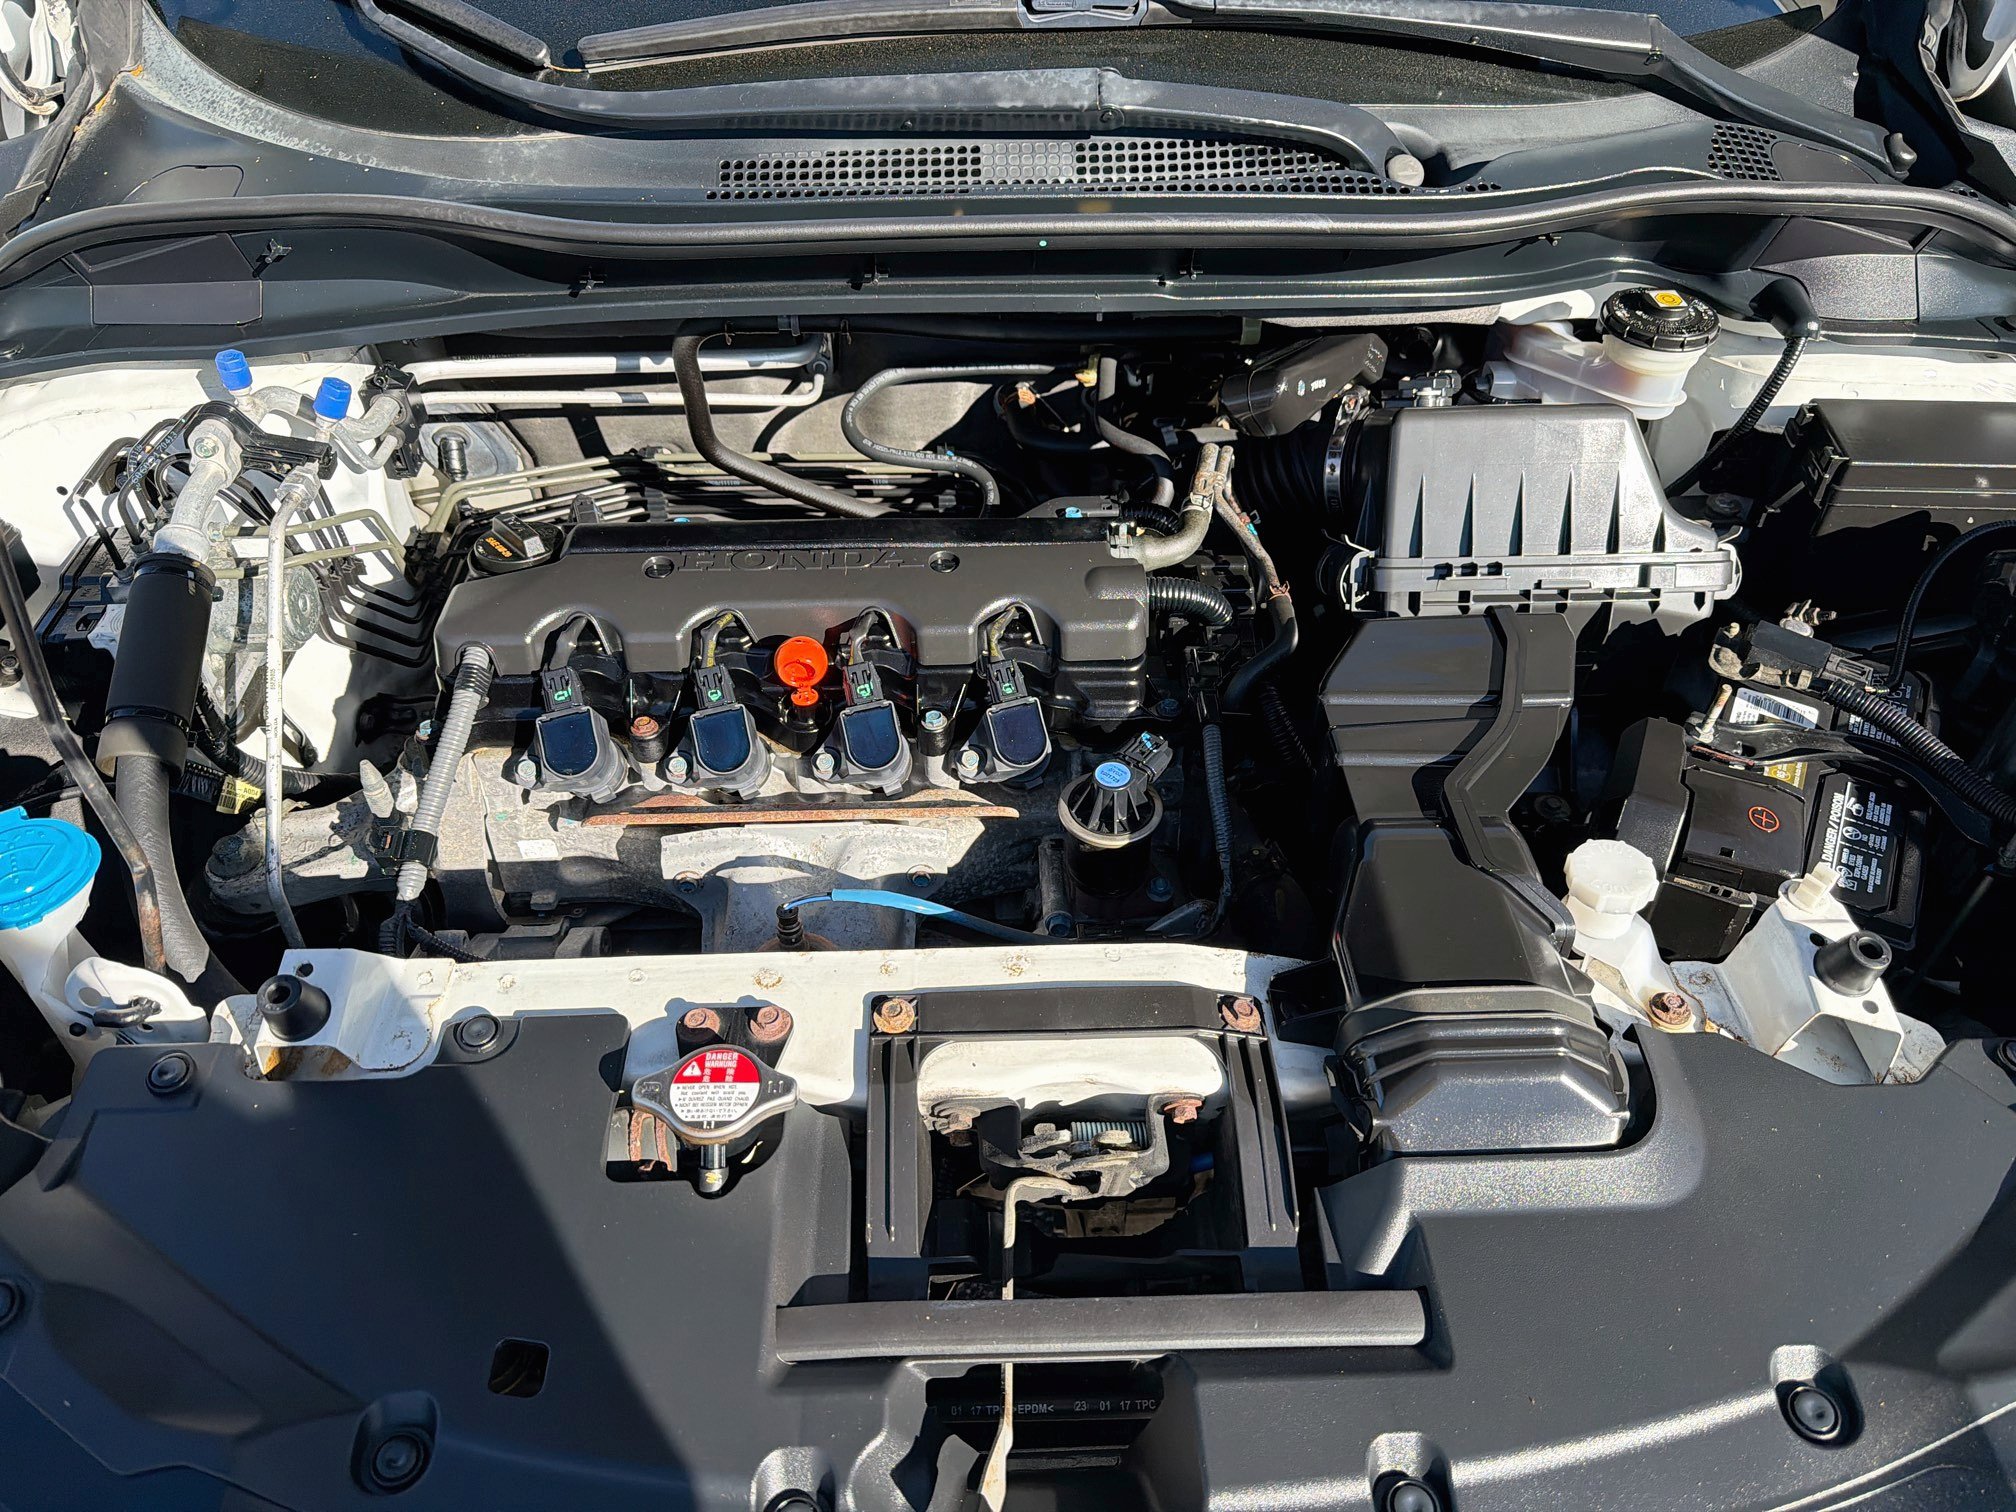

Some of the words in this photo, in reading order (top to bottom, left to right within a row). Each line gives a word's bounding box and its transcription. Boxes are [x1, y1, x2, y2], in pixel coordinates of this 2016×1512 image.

[677, 551, 924, 571] HONDA
[1829, 792, 1845, 823] POISON
[1821, 826, 1838, 862] DANGER
[1847, 854, 1856, 866] EYES
[1861, 865, 1869, 880] GASES
[705, 1060, 738, 1068] WARNUNG
[706, 1052, 739, 1060] DANGER
[951, 1405, 962, 1416] 01
[970, 1405, 982, 1416] 17
[985, 1405, 1005, 1416] TP
[1099, 1400, 1111, 1412] 01
[1120, 1400, 1131, 1411] 17
[1135, 1399, 1157, 1411] TPC
